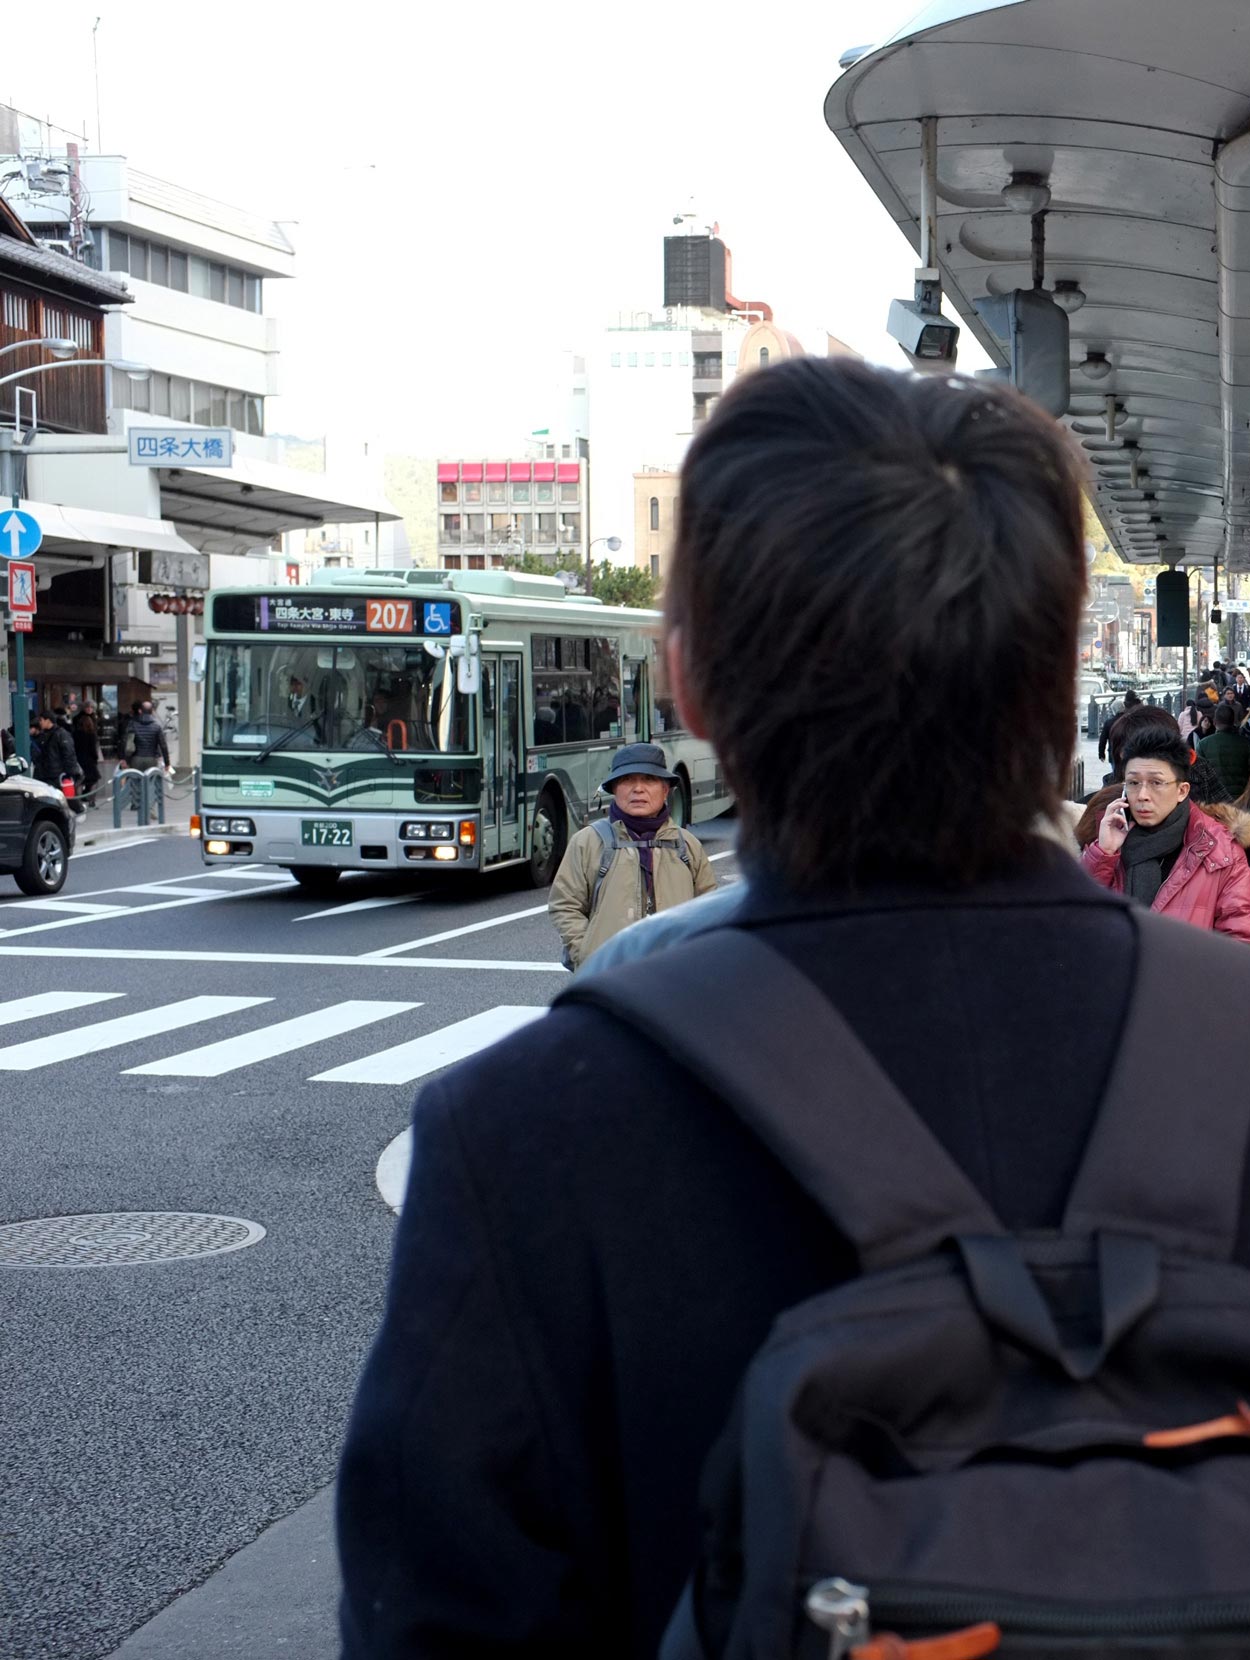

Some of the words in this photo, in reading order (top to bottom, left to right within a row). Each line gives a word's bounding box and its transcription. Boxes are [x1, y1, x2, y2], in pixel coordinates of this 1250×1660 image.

[137, 436, 224, 459] 四条大橋
[275, 606, 354, 621] 四条大宮・東寺
[369, 603, 408, 629] 207
[312, 828, 351, 845] 17-22
